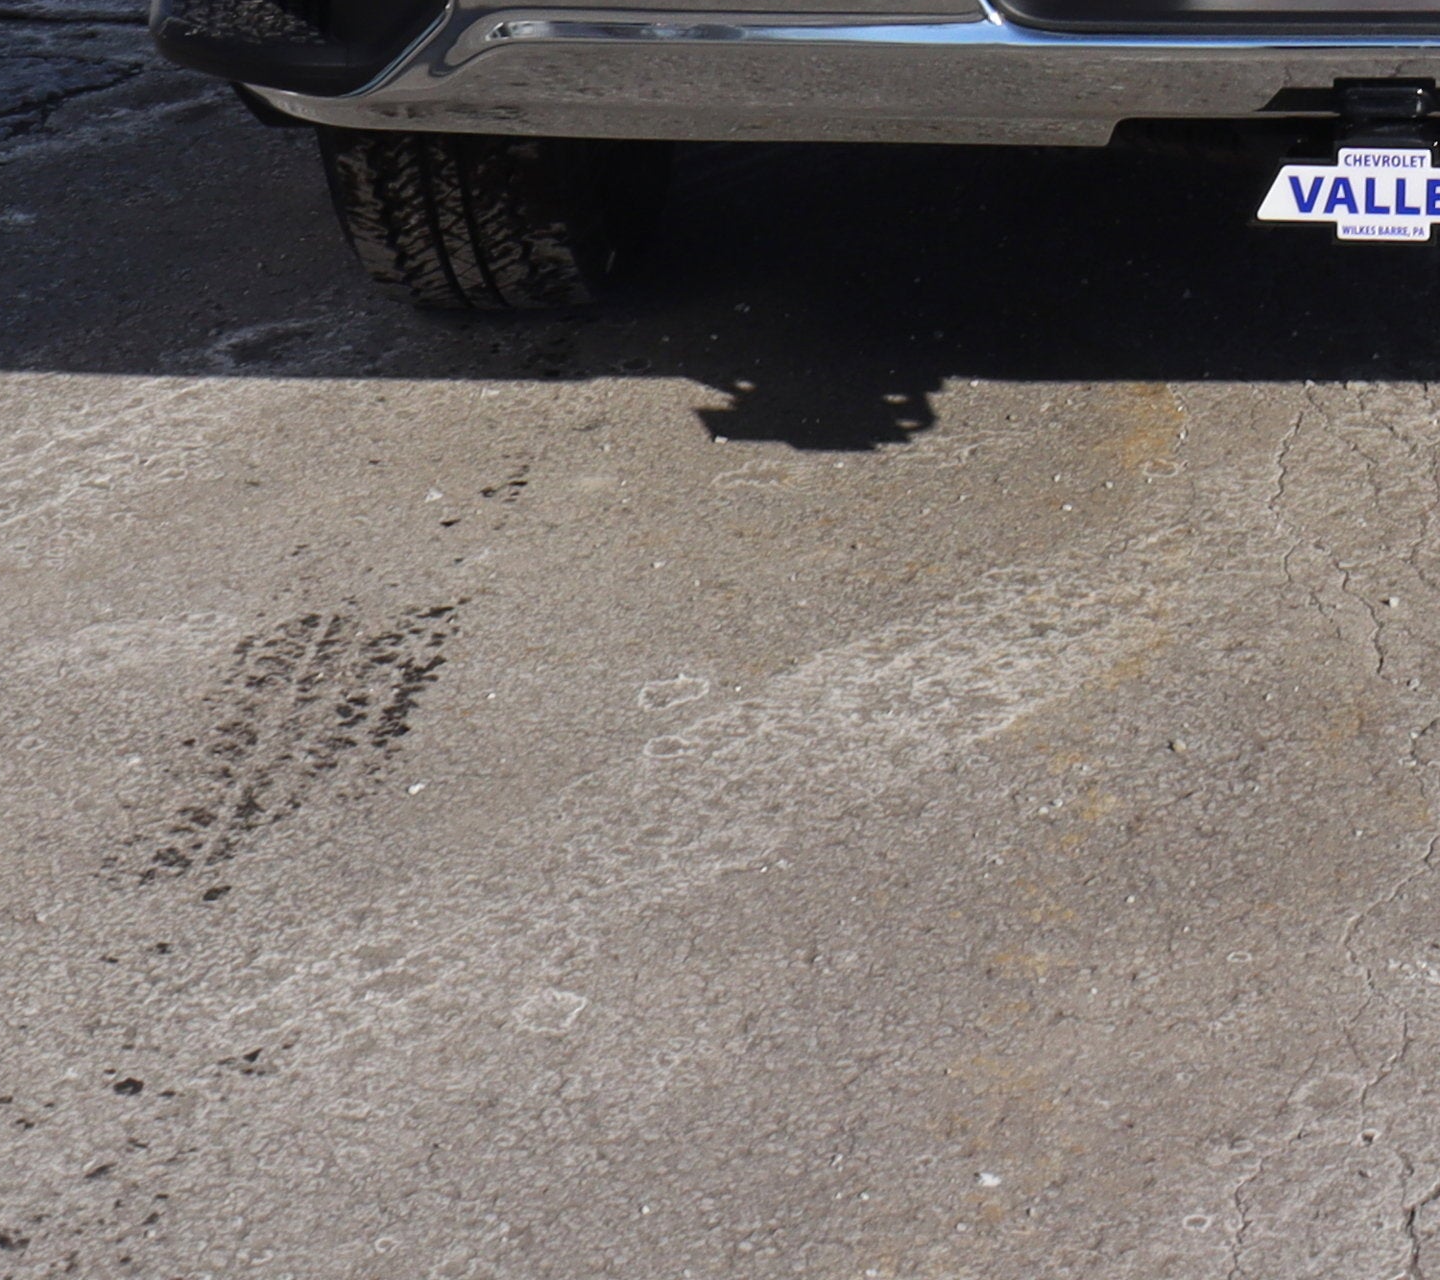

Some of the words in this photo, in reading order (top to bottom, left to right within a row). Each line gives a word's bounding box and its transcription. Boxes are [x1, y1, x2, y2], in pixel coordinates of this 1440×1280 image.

[1343, 153, 1427, 169] CHEVROLET
[1341, 225, 1376, 236] WILKES
[1378, 226, 1411, 238] BARRE,
[1413, 227, 1425, 237] PA
